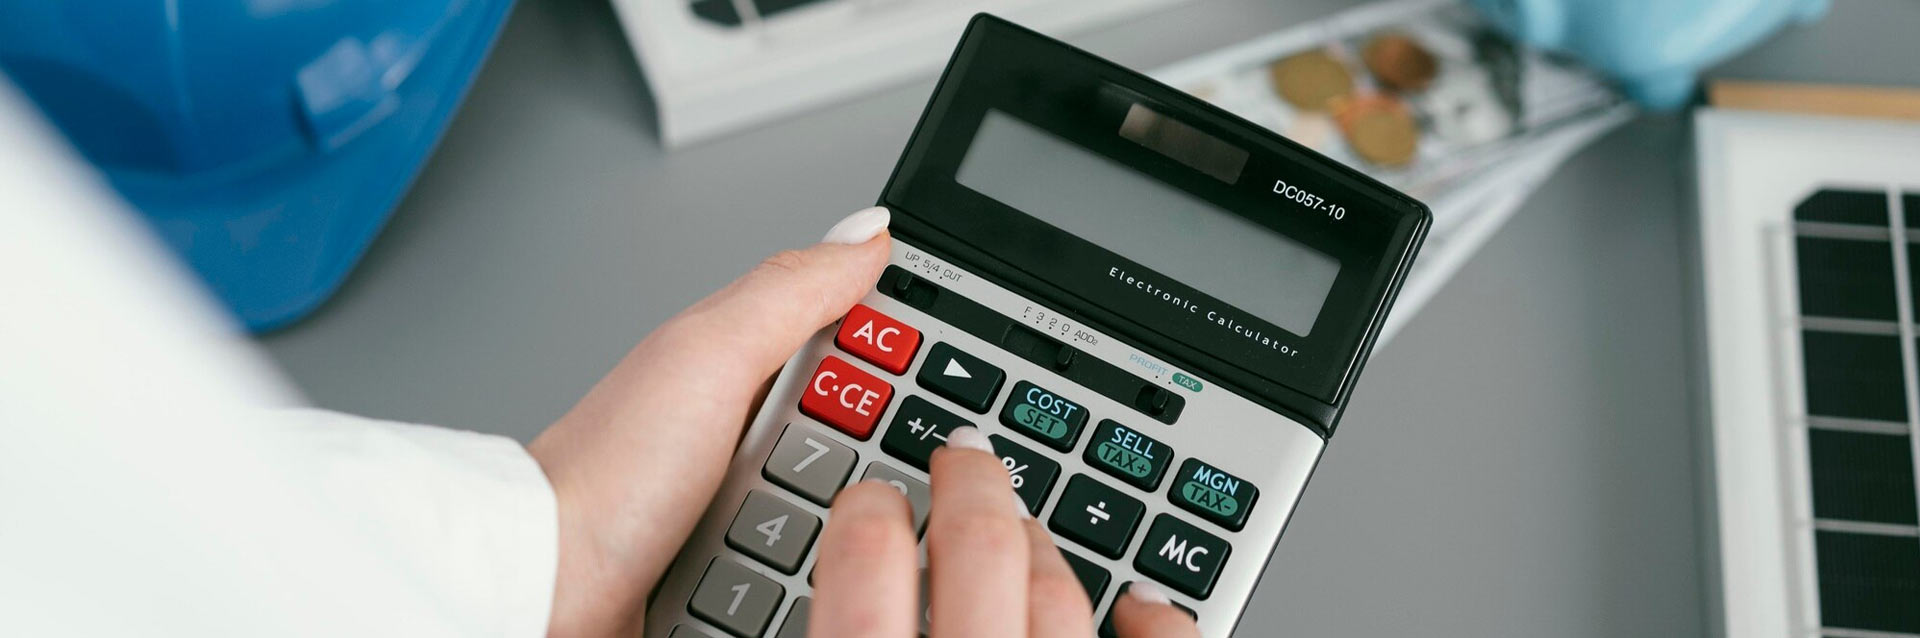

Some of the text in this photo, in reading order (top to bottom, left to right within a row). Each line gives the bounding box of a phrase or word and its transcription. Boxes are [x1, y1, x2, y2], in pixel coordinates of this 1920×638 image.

[1273, 180, 1346, 221] DC057-10
[905, 251, 963, 282] UP 5/4 CUT
[1024, 306, 1032, 315] F
[1036, 312, 1045, 321] 3
[1049, 318, 1058, 327] 2
[1109, 267, 1299, 357] Electronic Calculator
[853, 320, 900, 352] AC
[1129, 354, 1198, 390] PROFIT TAX
[1026, 388, 1077, 420] COST
[1023, 410, 1060, 436] SET
[792, 437, 830, 473] 7
[1104, 444, 1147, 474] TAX+
[1111, 427, 1154, 459] SELL
[1001, 456, 1028, 489] %
[1193, 465, 1239, 497] MGN
[1190, 484, 1231, 512] TAX-
[756, 514, 789, 547] 4
[1158, 534, 1209, 572] MC
[727, 583, 751, 616] 1
